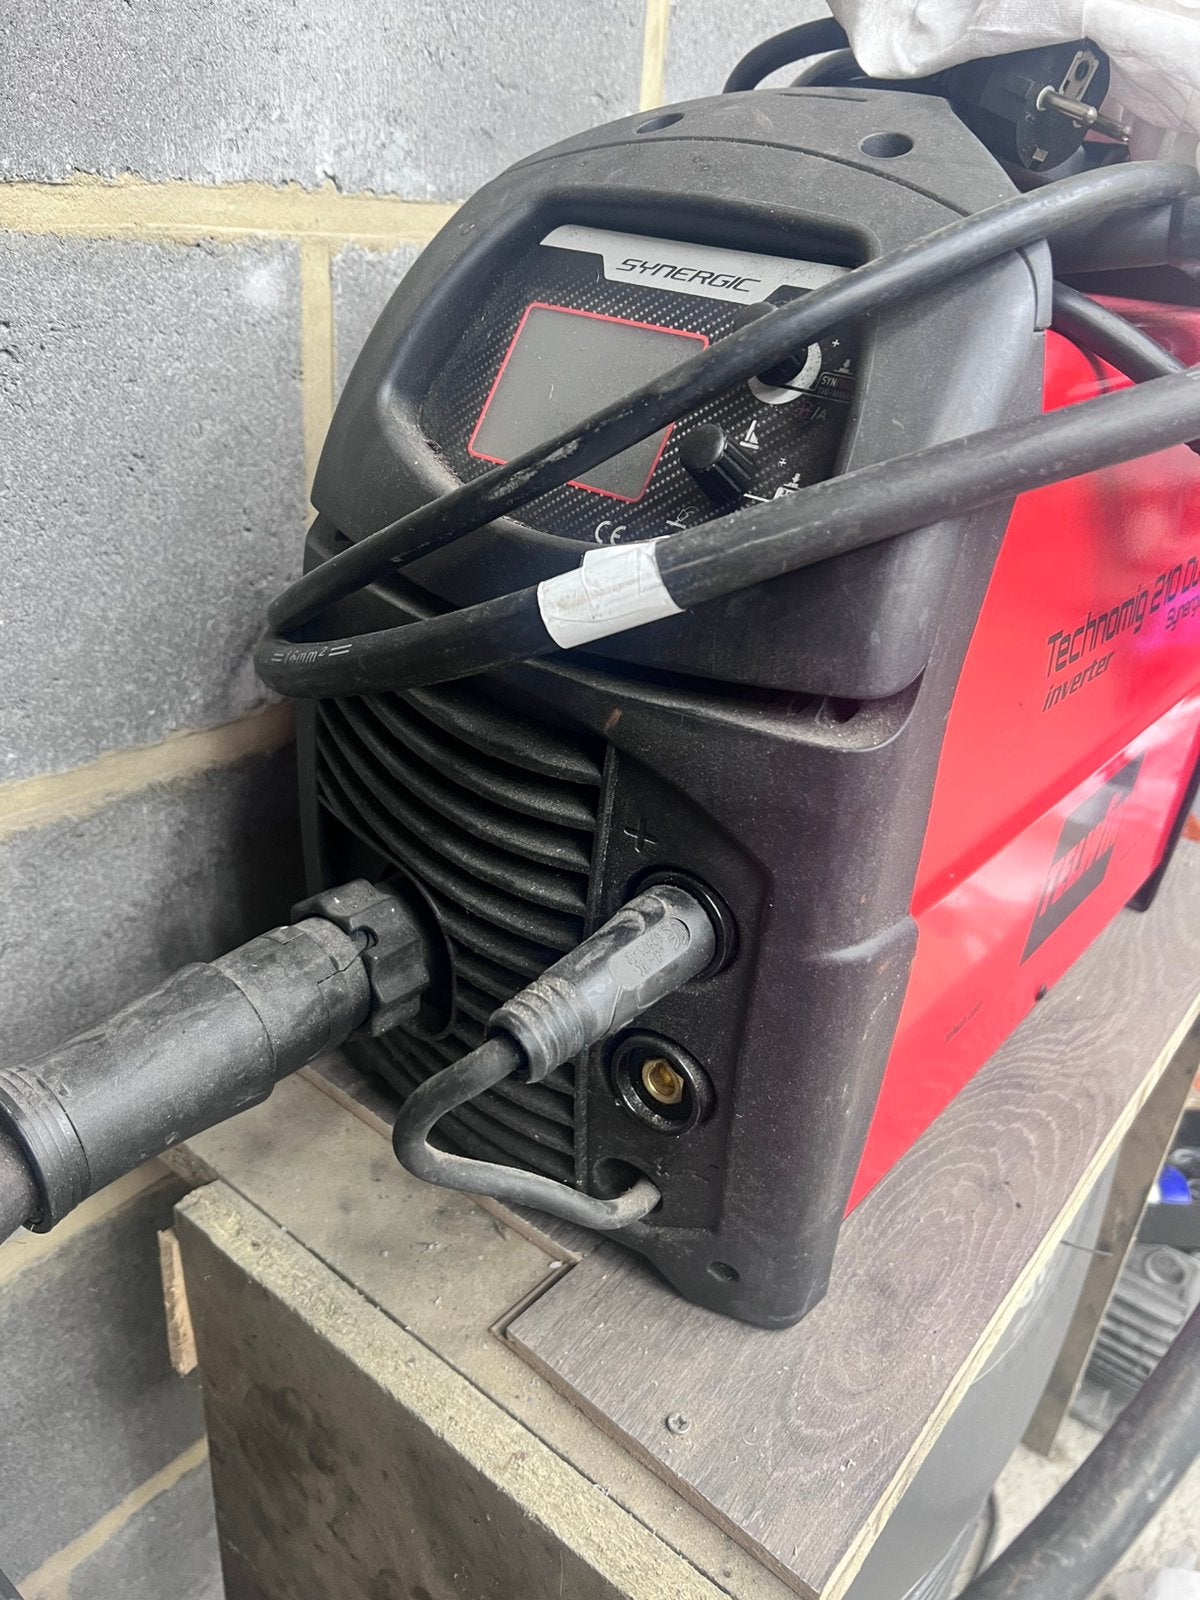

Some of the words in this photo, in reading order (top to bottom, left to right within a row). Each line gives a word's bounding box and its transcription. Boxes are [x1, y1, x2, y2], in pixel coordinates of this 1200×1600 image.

[616, 258, 762, 293] SYNERGIC
[1047, 583, 1149, 679] Technomig
[1149, 564, 1183, 615] 210
[1042, 650, 1115, 713] inverter
